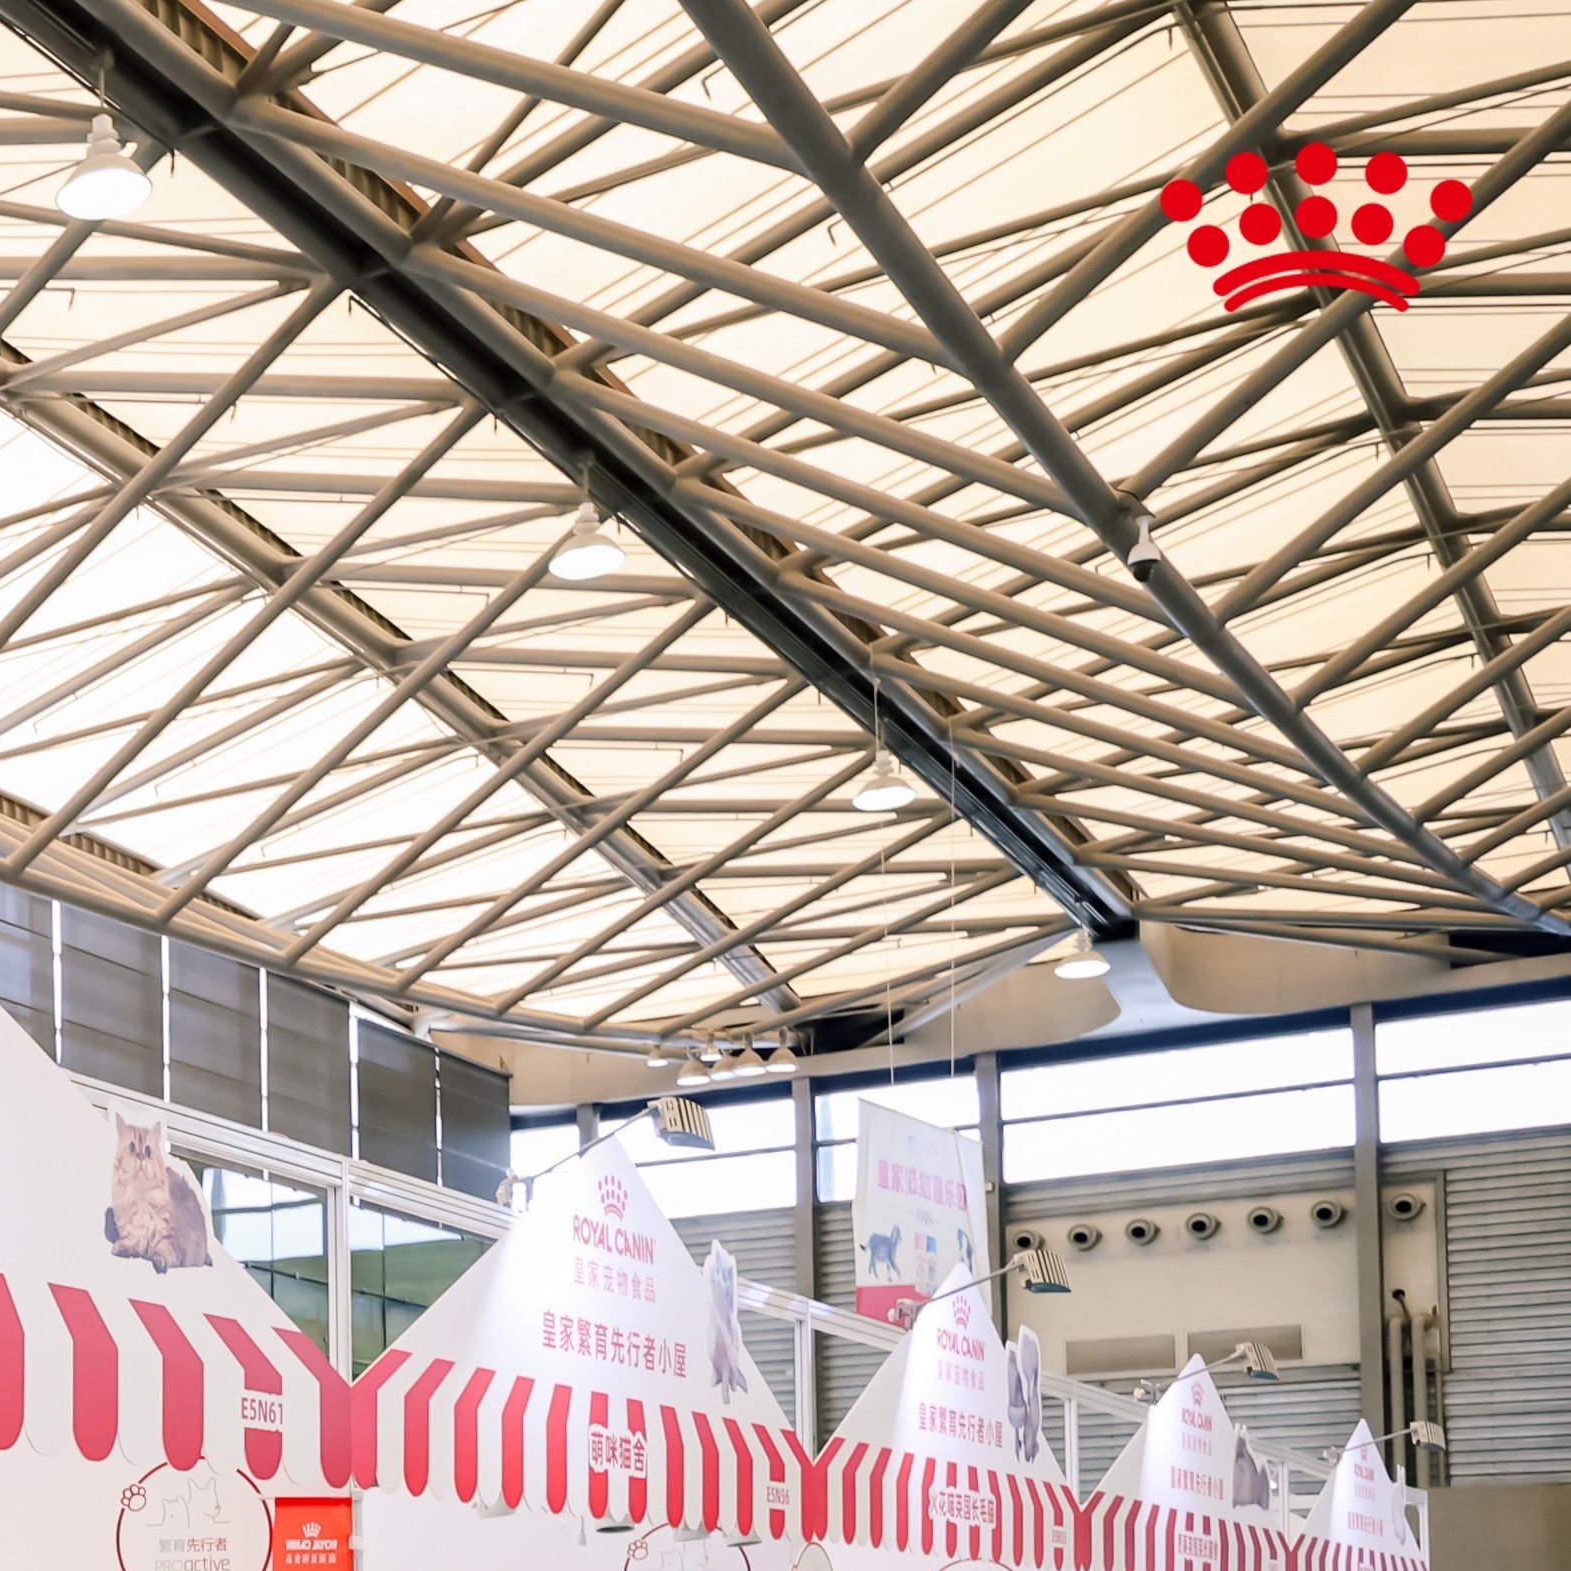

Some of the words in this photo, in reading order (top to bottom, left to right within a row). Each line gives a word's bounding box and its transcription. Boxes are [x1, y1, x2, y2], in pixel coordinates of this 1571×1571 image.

[573, 1213, 612, 1254] ROYAL
[614, 1230, 654, 1265] CANIN
[573, 1256, 657, 1303] 皇家宠物食品
[542, 1308, 687, 1379] 皇家繁育先行者小屋
[937, 1327, 960, 1355] ROYAL
[961, 1334, 985, 1362] CANIN
[240, 1395, 285, 1426] E5N61
[590, 1430, 647, 1473] 萌咪猫舍
[159, 1537, 228, 1552] 繁育先行者
